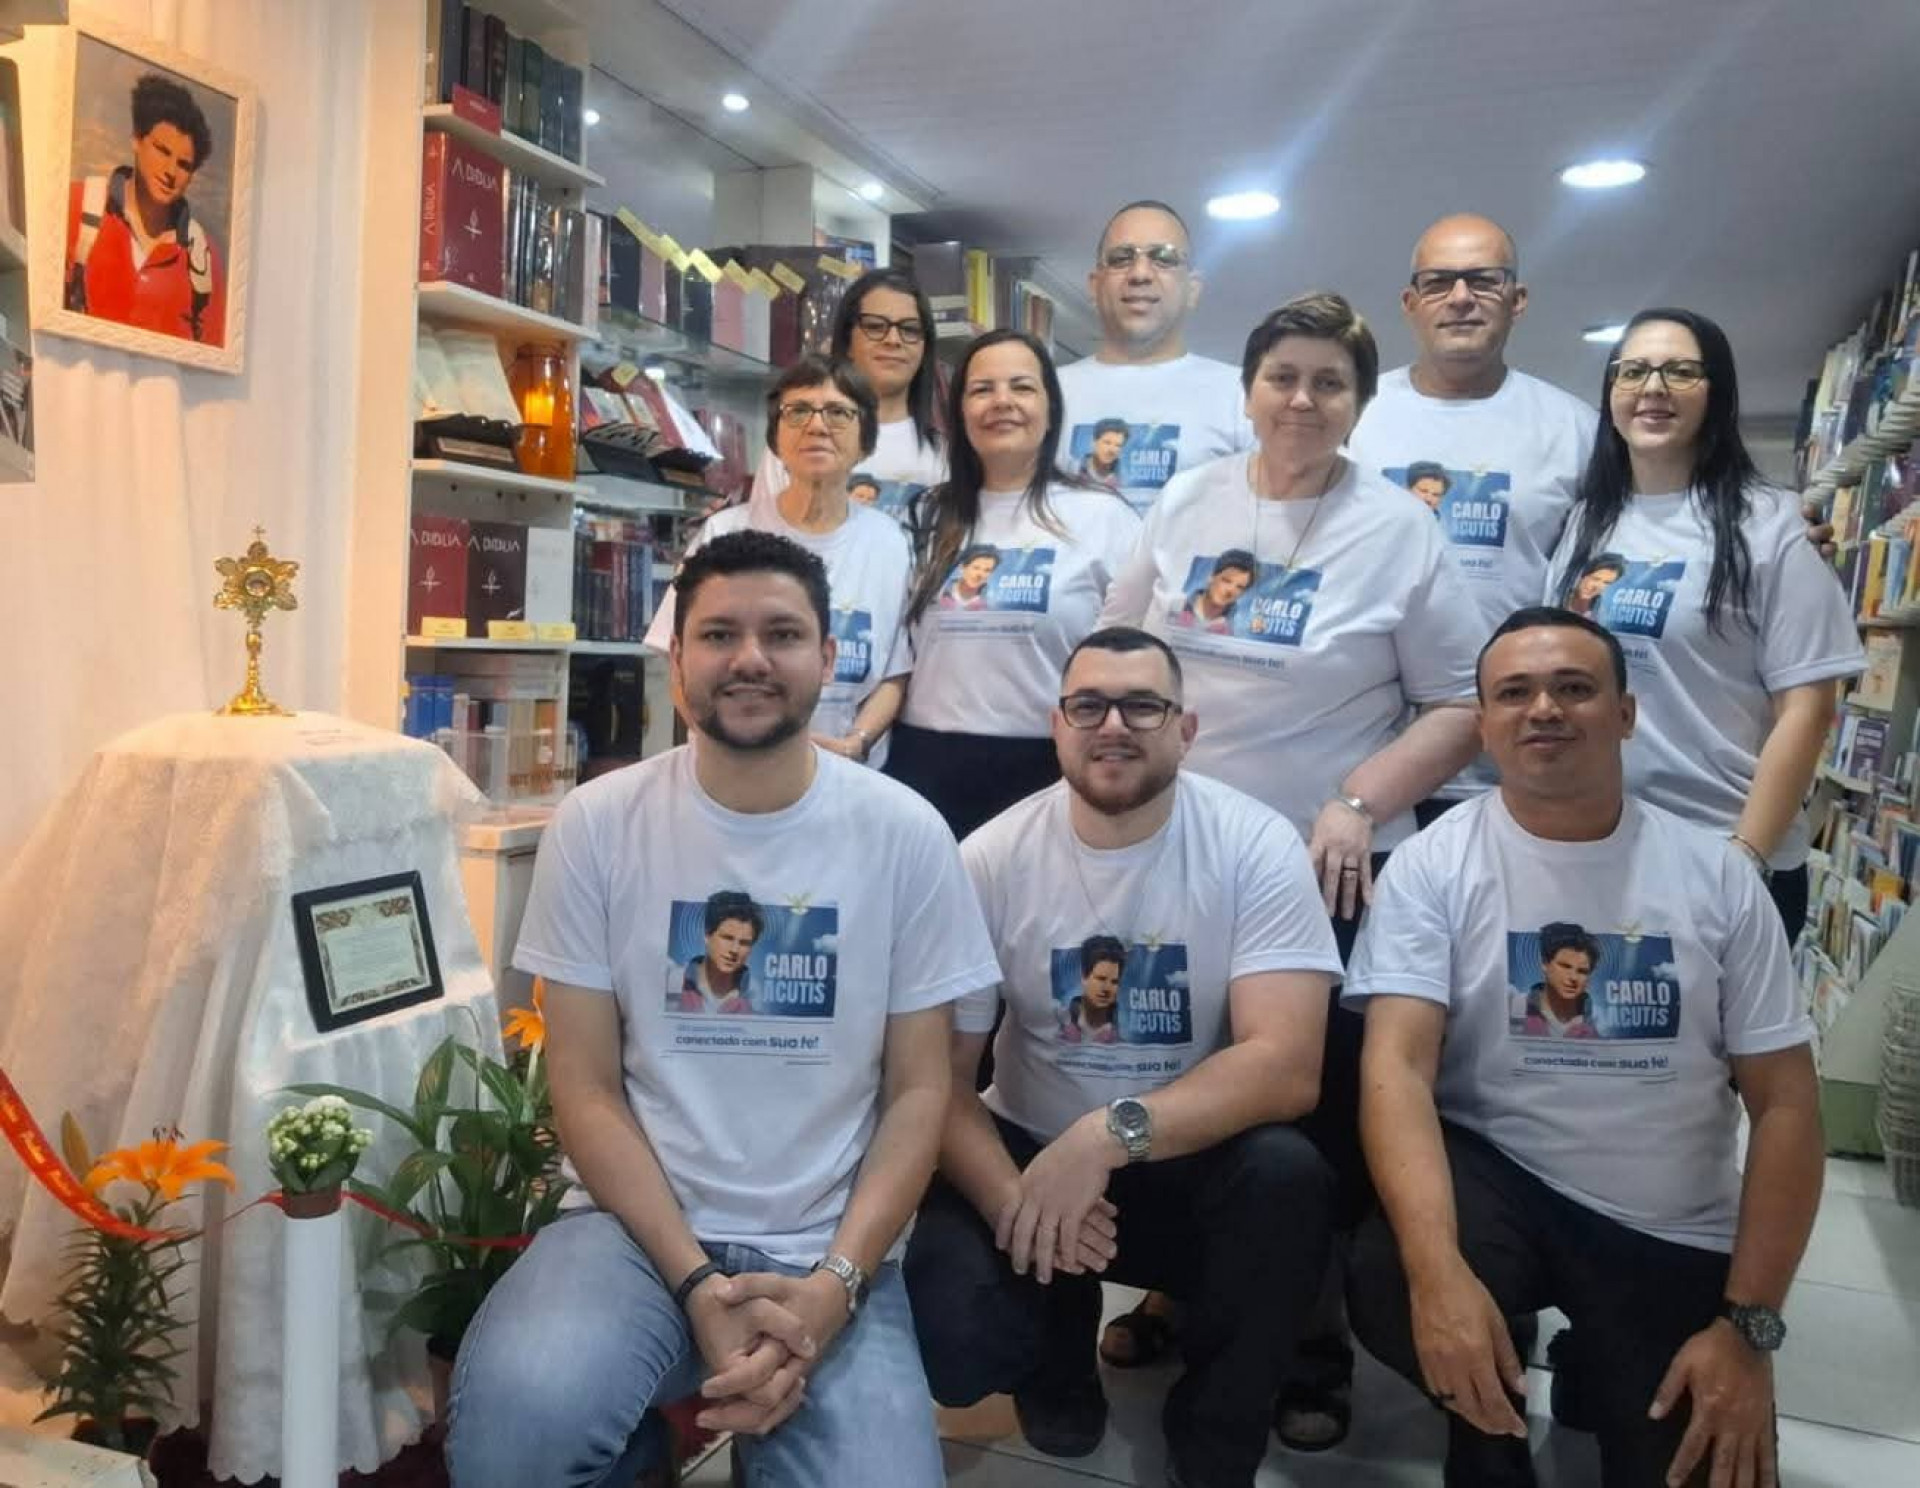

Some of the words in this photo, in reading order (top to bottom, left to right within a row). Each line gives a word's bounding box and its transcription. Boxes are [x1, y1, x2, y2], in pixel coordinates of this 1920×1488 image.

[1129, 450, 1171, 465] CARLO
[1452, 502, 1501, 519] CARLO
[998, 574, 1045, 589] CARLO
[1612, 588, 1665, 609] CARLO
[836, 639, 867, 658] ARLO
[765, 953, 829, 980] CARLO
[763, 978, 826, 1005] ACUTIS
[1129, 987, 1182, 1012] CARLO
[1606, 979, 1671, 1006] CARLO
[1603, 1006, 1670, 1027] ACUTIS
[675, 1034, 740, 1047] conectado
[741, 1037, 768, 1047] com
[769, 1035, 799, 1050] sua
[1618, 1058, 1651, 1070] sua
